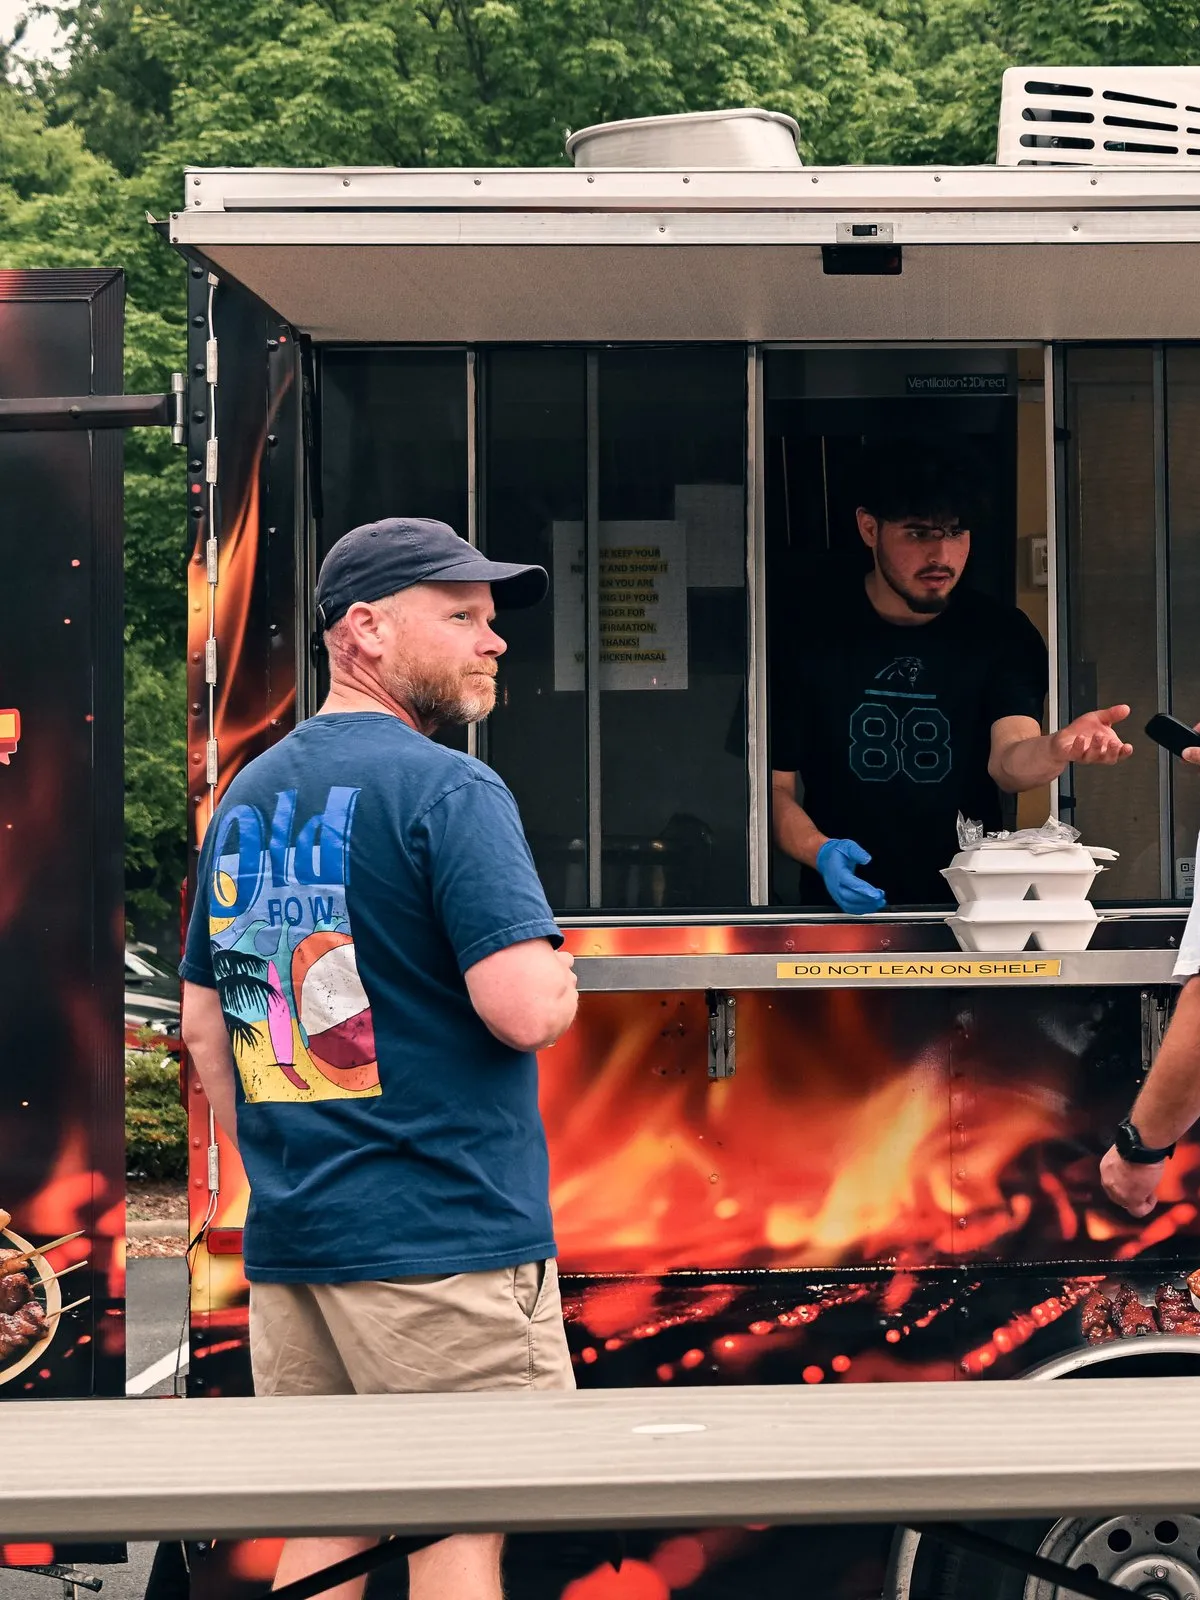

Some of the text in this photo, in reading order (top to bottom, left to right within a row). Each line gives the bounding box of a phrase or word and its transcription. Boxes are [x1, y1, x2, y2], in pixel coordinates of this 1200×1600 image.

[907, 376, 1005, 388] Ventilation Direct
[636, 549, 660, 557] YOUR
[608, 565, 628, 573] AND
[630, 565, 657, 573] SHOW
[660, 564, 668, 573] IT
[615, 579, 634, 587] YOU
[637, 579, 654, 587] ARE
[619, 594, 631, 602] UP
[633, 594, 659, 602] YOUR
[627, 609, 645, 617] FOR
[635, 653, 667, 662] INASAL
[848, 702, 953, 784] 88
[210, 787, 362, 918] Old
[828, 965, 872, 975] NOT
[879, 964, 934, 975] LEAN
[940, 964, 971, 975] ON
[979, 963, 1047, 975] SHELF
